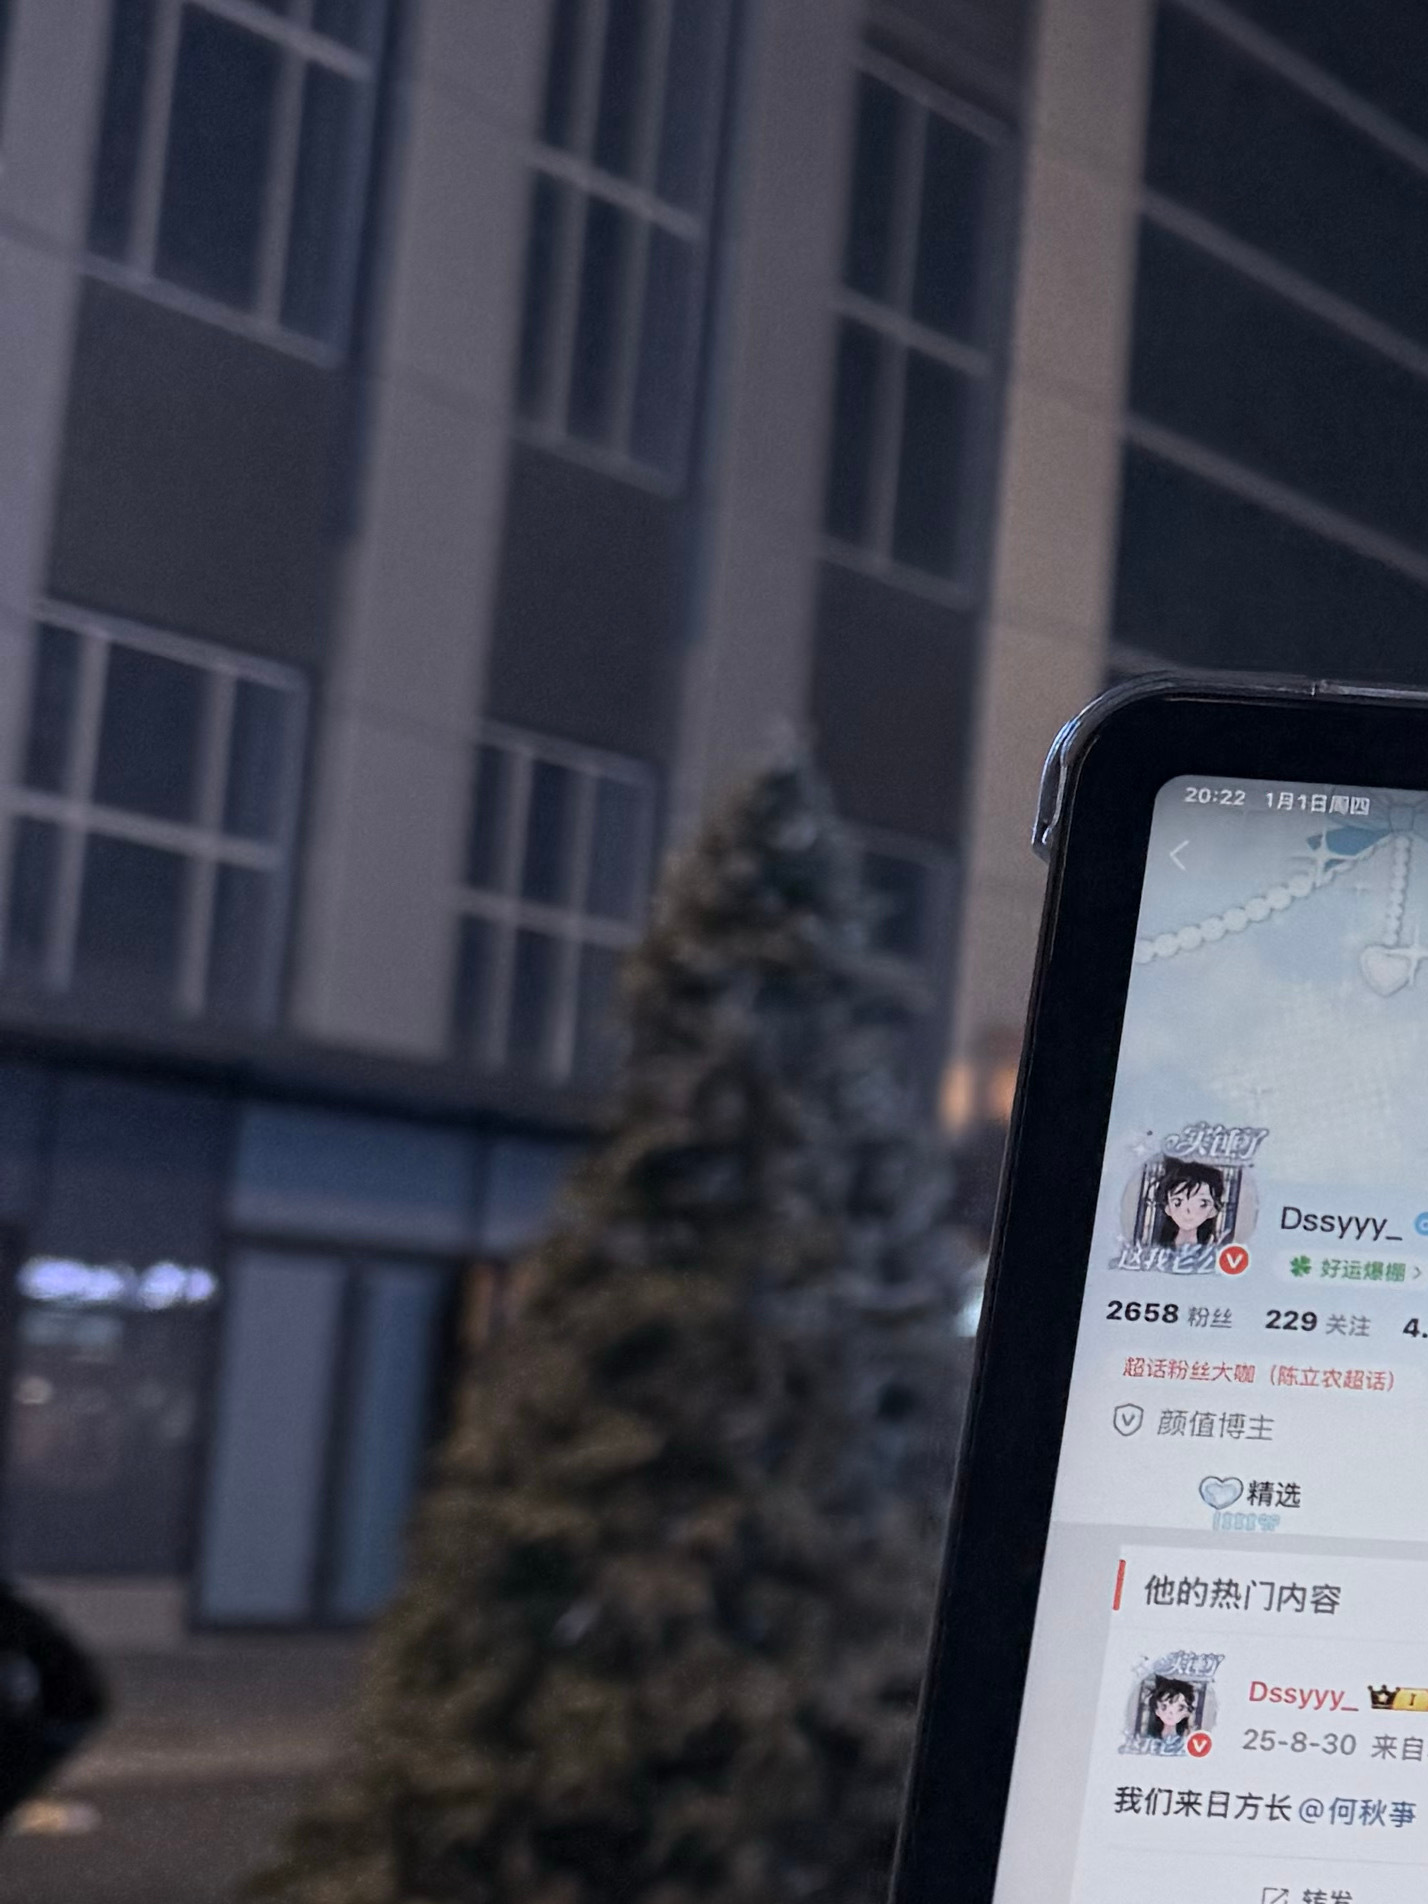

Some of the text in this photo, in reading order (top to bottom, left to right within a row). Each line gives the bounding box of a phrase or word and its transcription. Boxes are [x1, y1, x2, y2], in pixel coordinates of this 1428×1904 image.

[1184, 786, 1371, 816] 20:22 1月1日周四
[1319, 1257, 1407, 1282] 好运爆棚
[1104, 1299, 1180, 1325] 2658
[1187, 1306, 1234, 1330] 粉丝
[1265, 1309, 1319, 1333] 229
[1325, 1314, 1372, 1338] 关注
[1157, 1408, 1275, 1442] 颜值博主
[1247, 1480, 1301, 1508] 精选
[1144, 1574, 1343, 1616] 他的热门内容
[1242, 1728, 1358, 1757] 25-8-30
